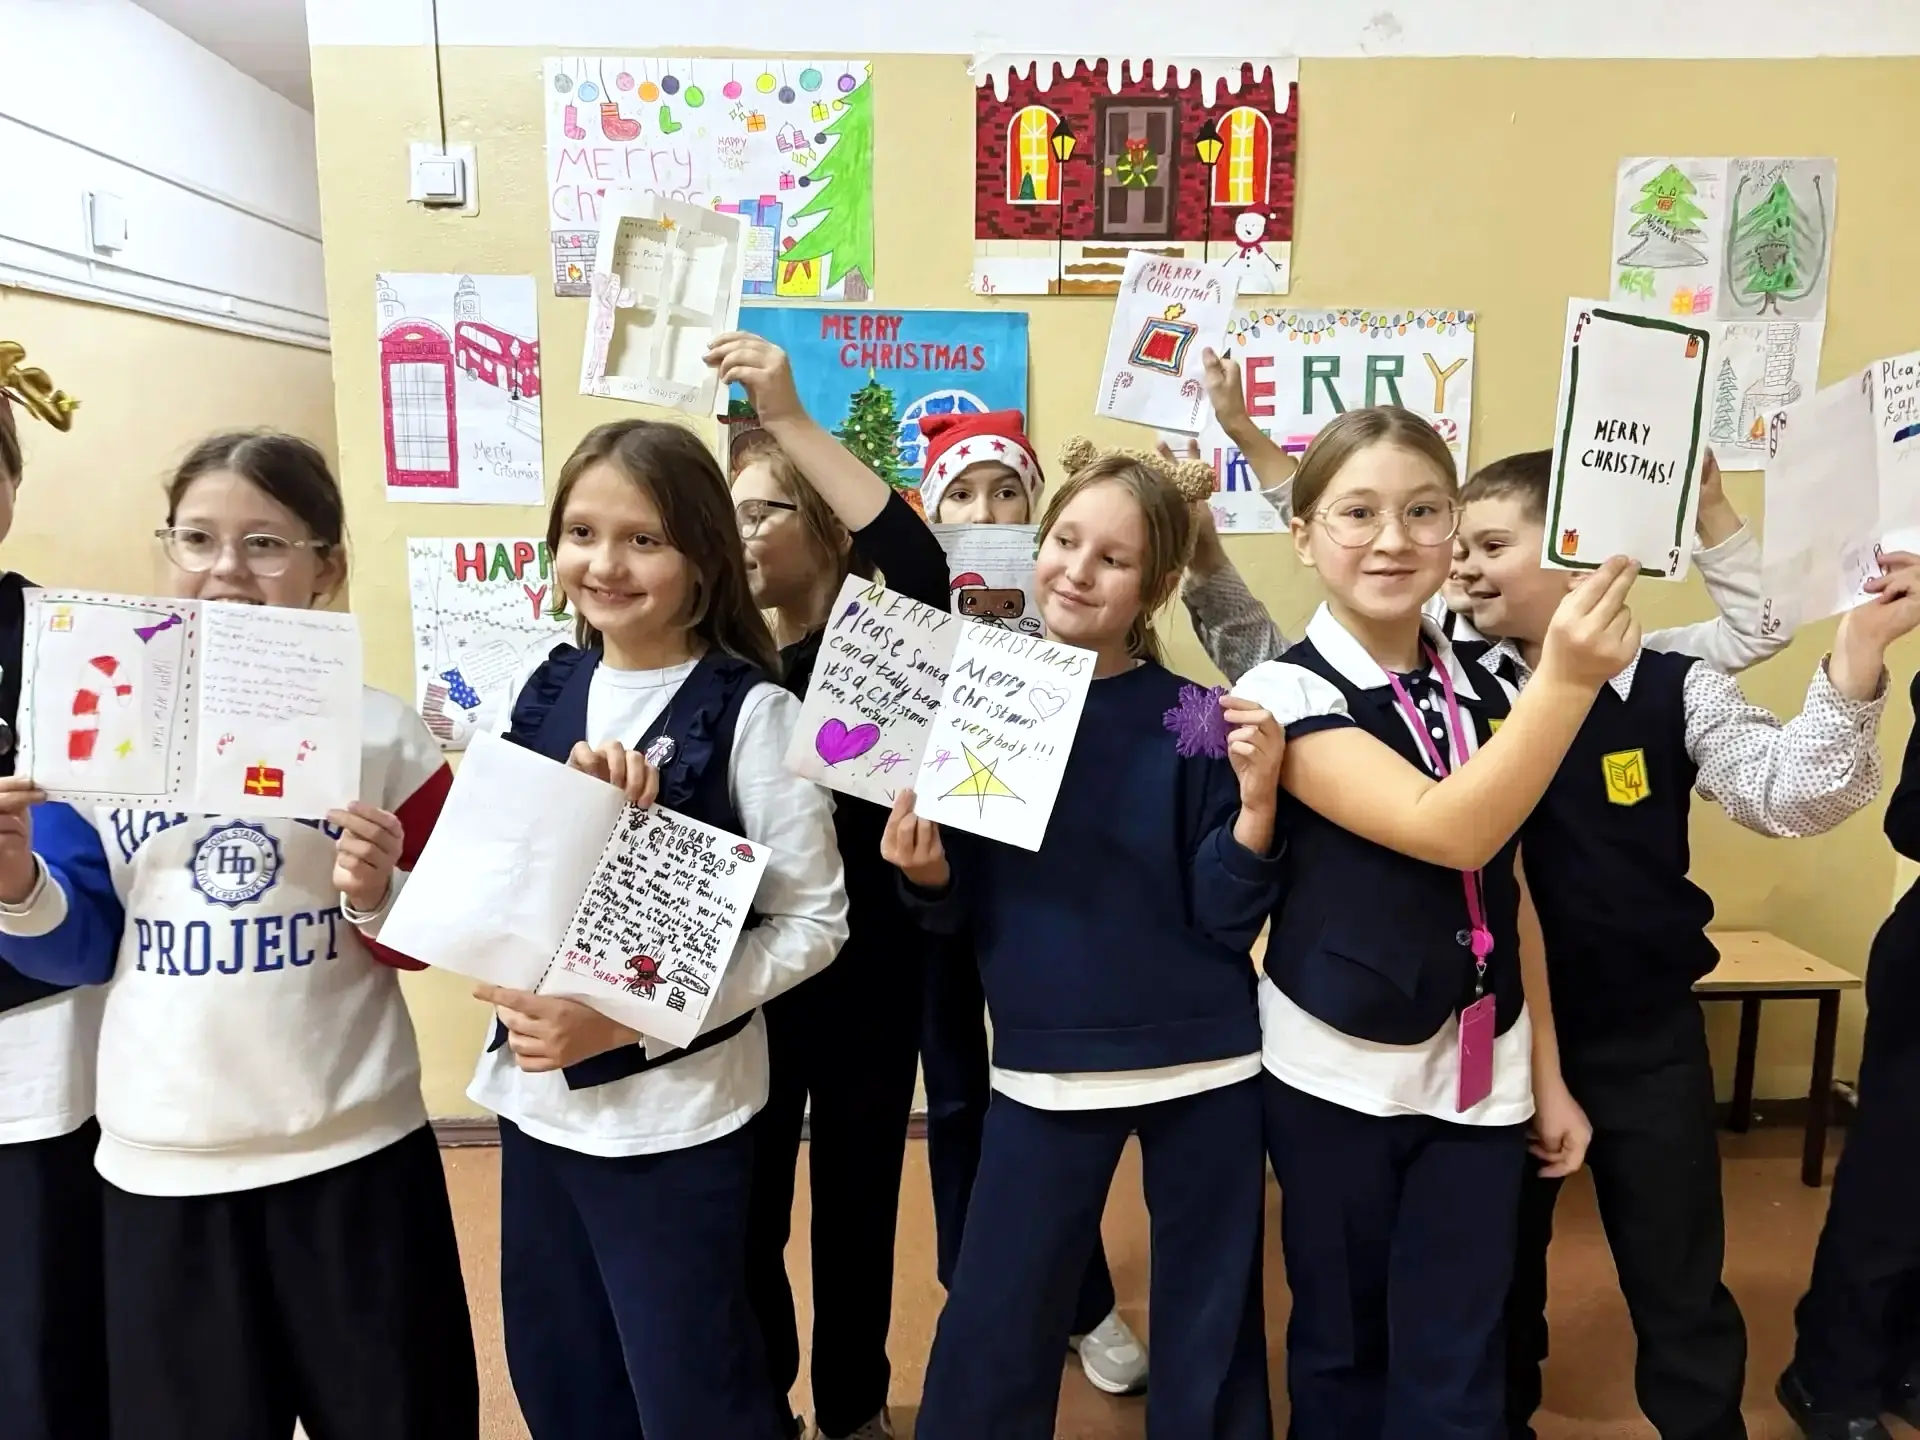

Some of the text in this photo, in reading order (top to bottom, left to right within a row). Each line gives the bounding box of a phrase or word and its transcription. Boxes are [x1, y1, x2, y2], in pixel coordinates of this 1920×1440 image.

[1156, 260, 1202, 281] MERRY
[821, 315, 904, 340] MERRY
[840, 343, 986, 371] CHRISTMAS
[1222, 349, 1468, 416] ERRY
[472, 439, 512, 464] Merry
[1594, 418, 1651, 446] MERRY
[1582, 449, 1675, 486] CHRISTMAS!
[832, 601, 905, 657] Please
[856, 583, 1089, 677] MERRY CHRISTMAS
[875, 663, 909, 700] teddy
[956, 657, 1025, 698] Merry
[866, 687, 929, 729] Christmas
[952, 684, 1038, 730] Christmas
[134, 907, 343, 976] PROJECT
